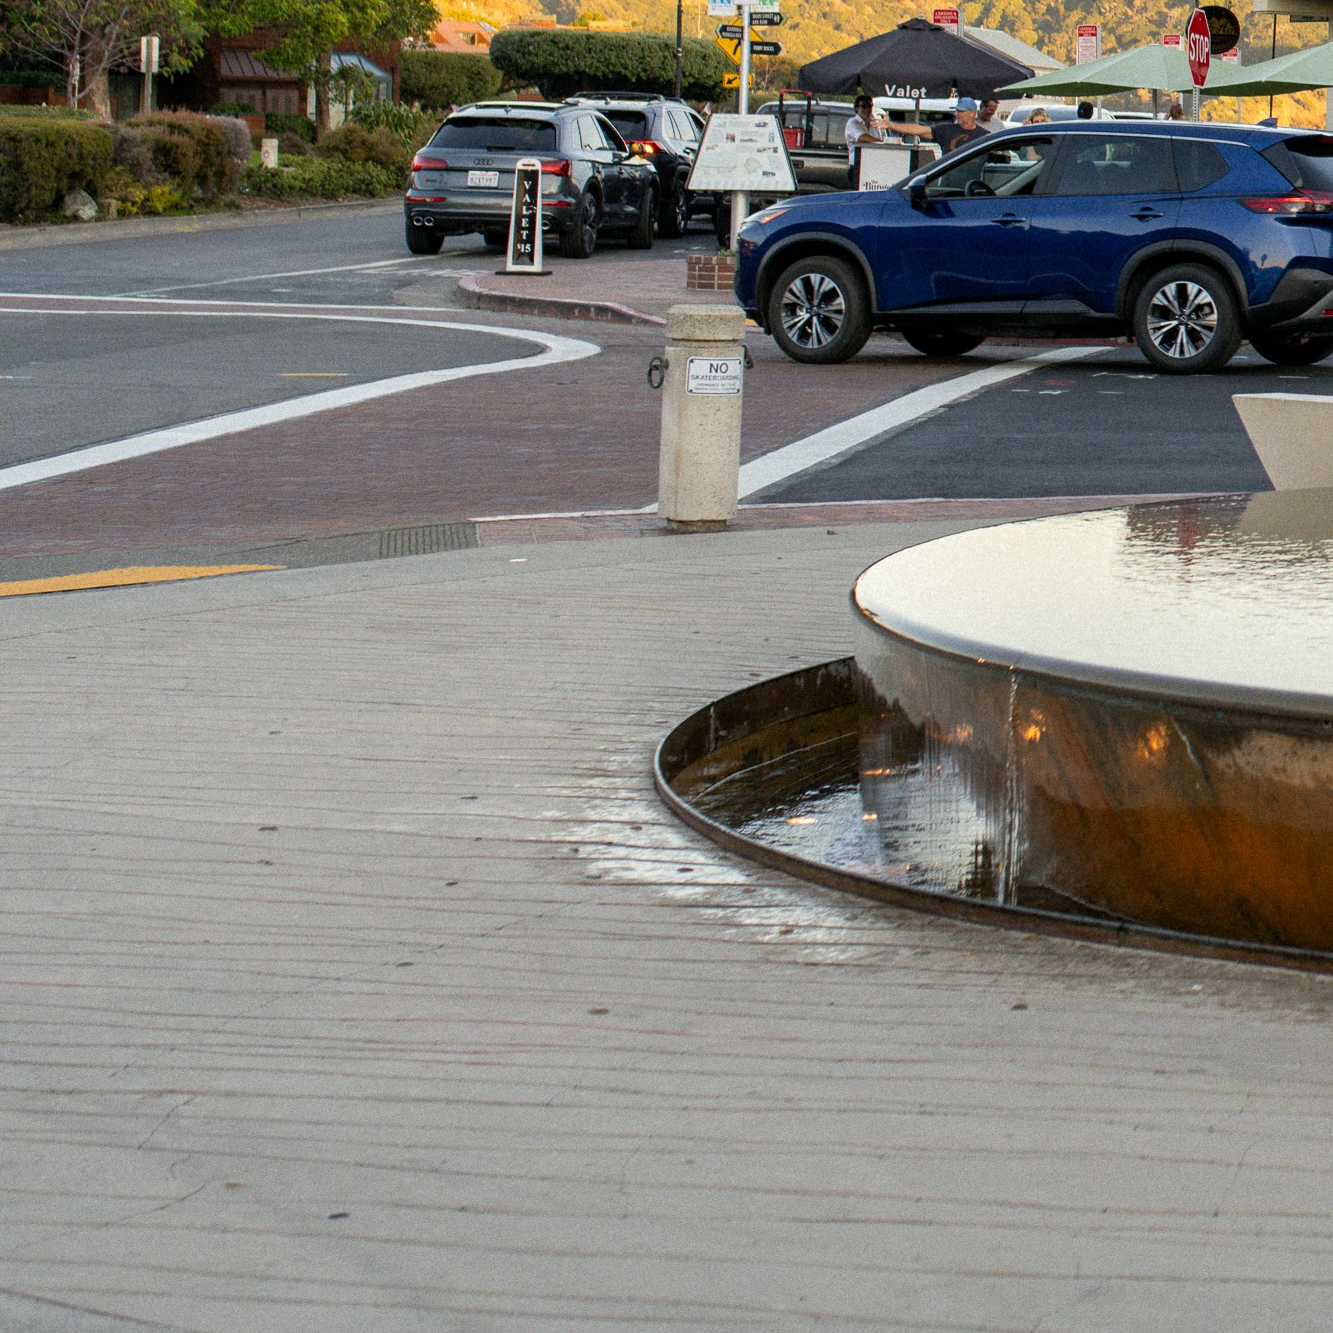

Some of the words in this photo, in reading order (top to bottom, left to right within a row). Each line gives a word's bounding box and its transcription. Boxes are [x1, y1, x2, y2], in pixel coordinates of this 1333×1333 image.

[1189, 32, 1209, 64] STOP
[884, 84, 927, 98] Valet
[520, 180, 532, 240] VALET
[709, 362, 729, 374] NO
